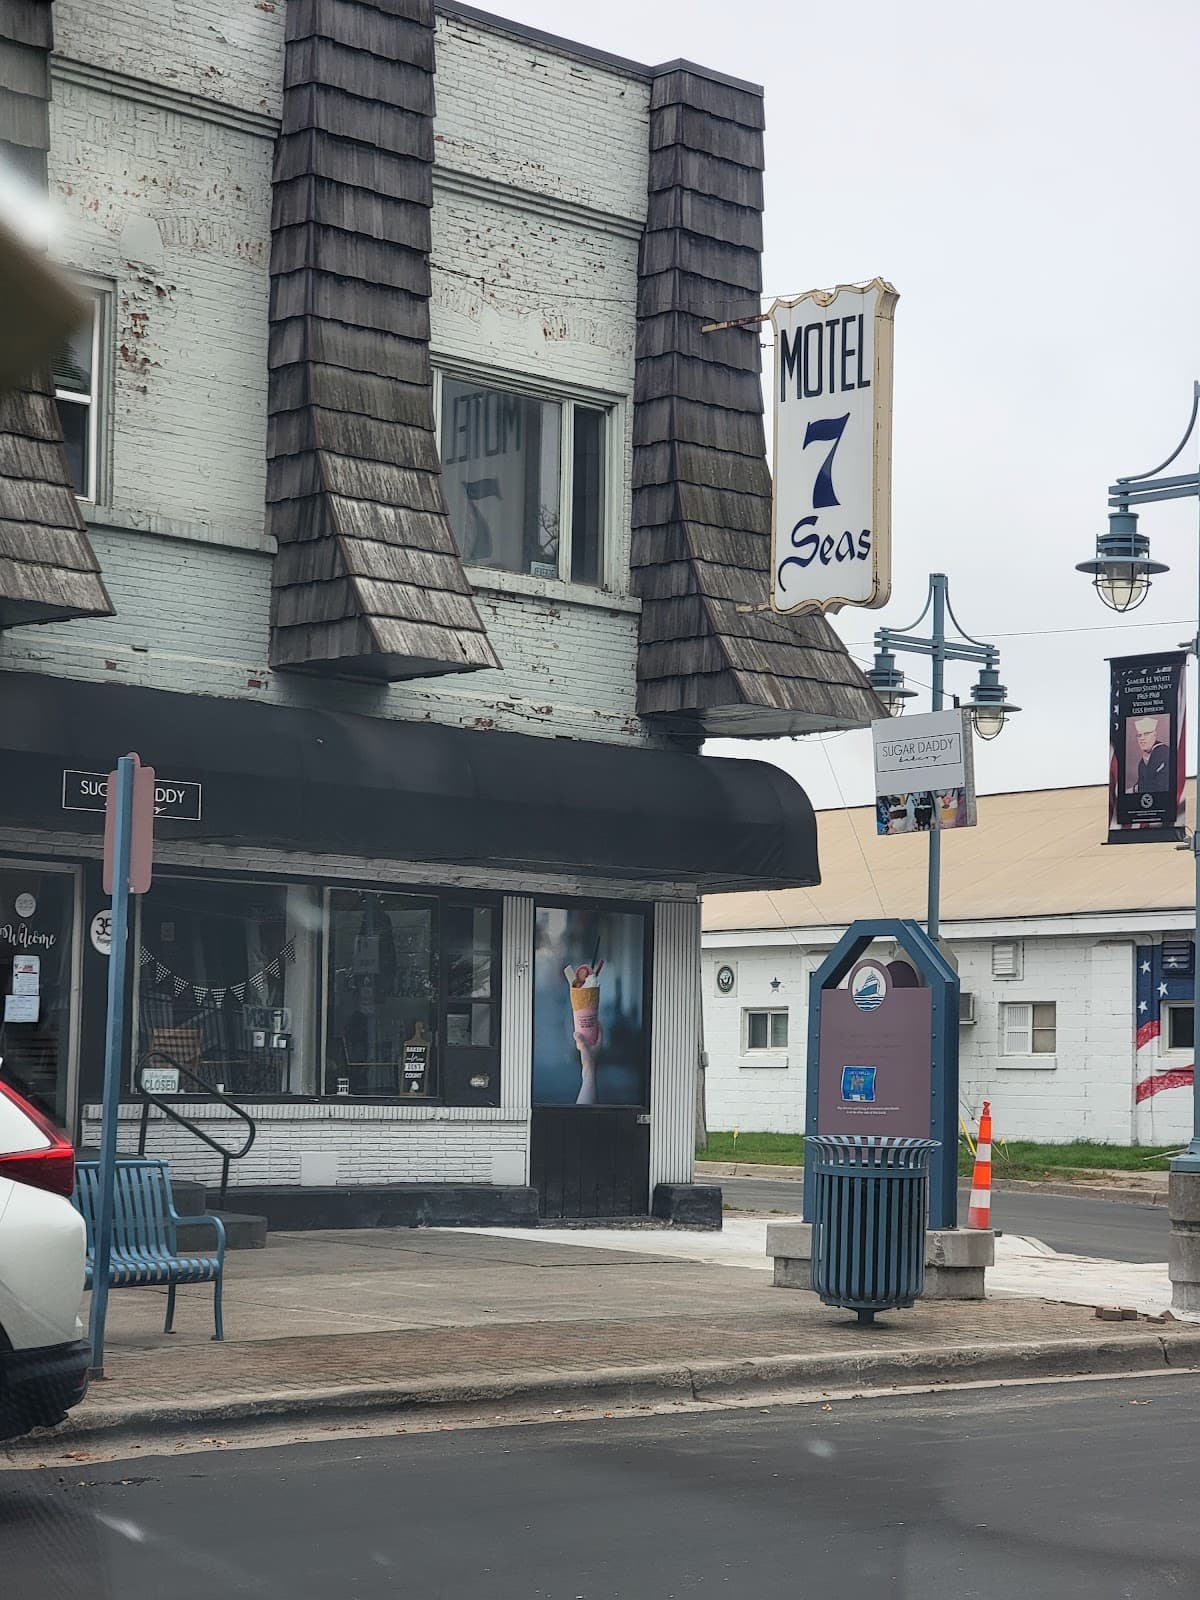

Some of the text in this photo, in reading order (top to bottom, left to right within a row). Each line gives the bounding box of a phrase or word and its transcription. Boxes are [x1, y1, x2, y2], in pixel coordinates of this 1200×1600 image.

[780, 313, 871, 402] MOTEL
[802, 411, 850, 508] 7
[778, 515, 871, 592] Seas
[882, 738, 953, 758] SUGAR DADDY
[80, 781, 185, 804] SUG DDY
[0, 922, 57, 949] Welcome
[144, 1079, 177, 1091] CLOSED
